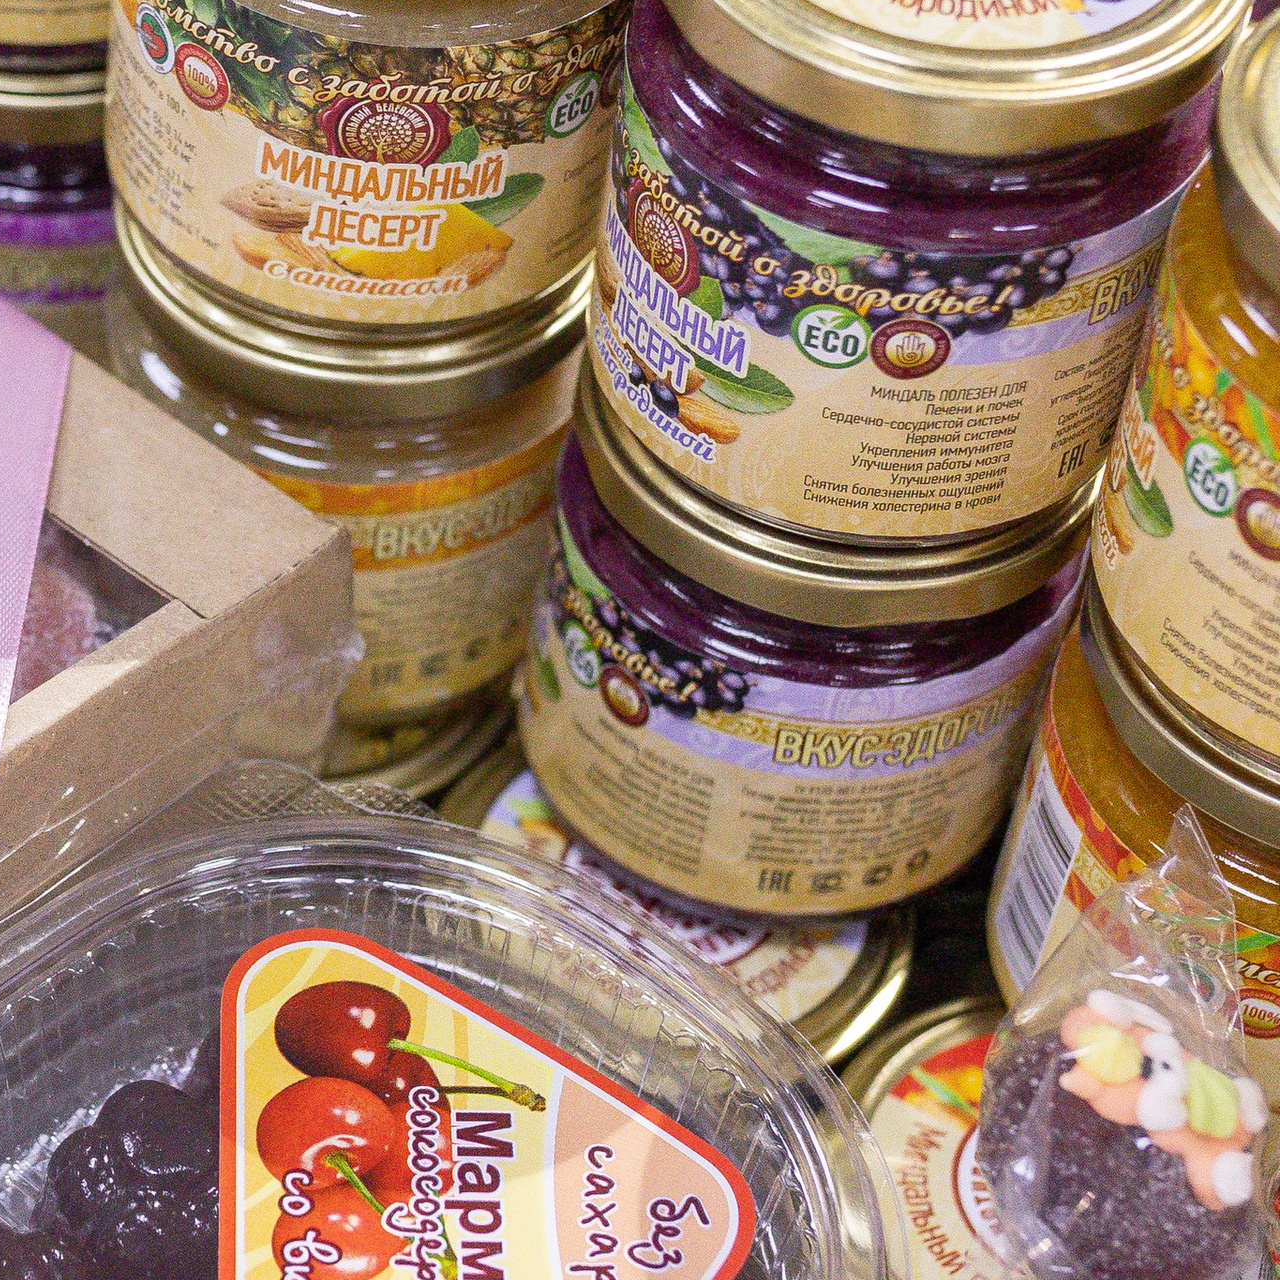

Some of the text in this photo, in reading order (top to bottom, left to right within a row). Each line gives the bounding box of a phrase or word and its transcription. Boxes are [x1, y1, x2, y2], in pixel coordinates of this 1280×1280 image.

[186, 63, 219, 92] 100%
[287, 65, 312, 87] с
[313, 70, 504, 107] заботой
[511, 69, 538, 95] о
[553, 91, 594, 129] ECO
[258, 142, 505, 202] МИНДАЛЬНЫЙ
[308, 205, 442, 248] ДЕСЕРТ
[627, 148, 748, 264] заботой
[752, 254, 783, 277] о
[782, 263, 1013, 318] здоровье!
[264, 261, 467, 297] с ананасом
[605, 199, 748, 374] МИНДАЛЬНЫЙ
[613, 286, 691, 389] ДЕСЕРТ
[801, 326, 860, 359] ECO
[870, 380, 1028, 404] МИНДАЛЬ ПОЛЕЗЕН ДЛЯ
[924, 403, 972, 418] Печени
[986, 397, 1024, 415] почек
[820, 406, 1021, 432] Сердечно-сосудистой системы
[904, 424, 1018, 446] Нервной системы
[850, 451, 1011, 474] Улучшения работы мозга
[858, 437, 1014, 460] Укрепления иммунитета
[803, 474, 1005, 501] Снятия болезненных ощущений
[889, 465, 1008, 489] Улучшения зрения
[1191, 456, 1230, 508] ECO
[802, 488, 869, 510] Снижения
[870, 498, 952, 515] холестерина
[964, 493, 1002, 513] крови
[773, 726, 882, 770] ВКУС
[280, 1168, 315, 1219] со
[626, 1193, 712, 1271] без
